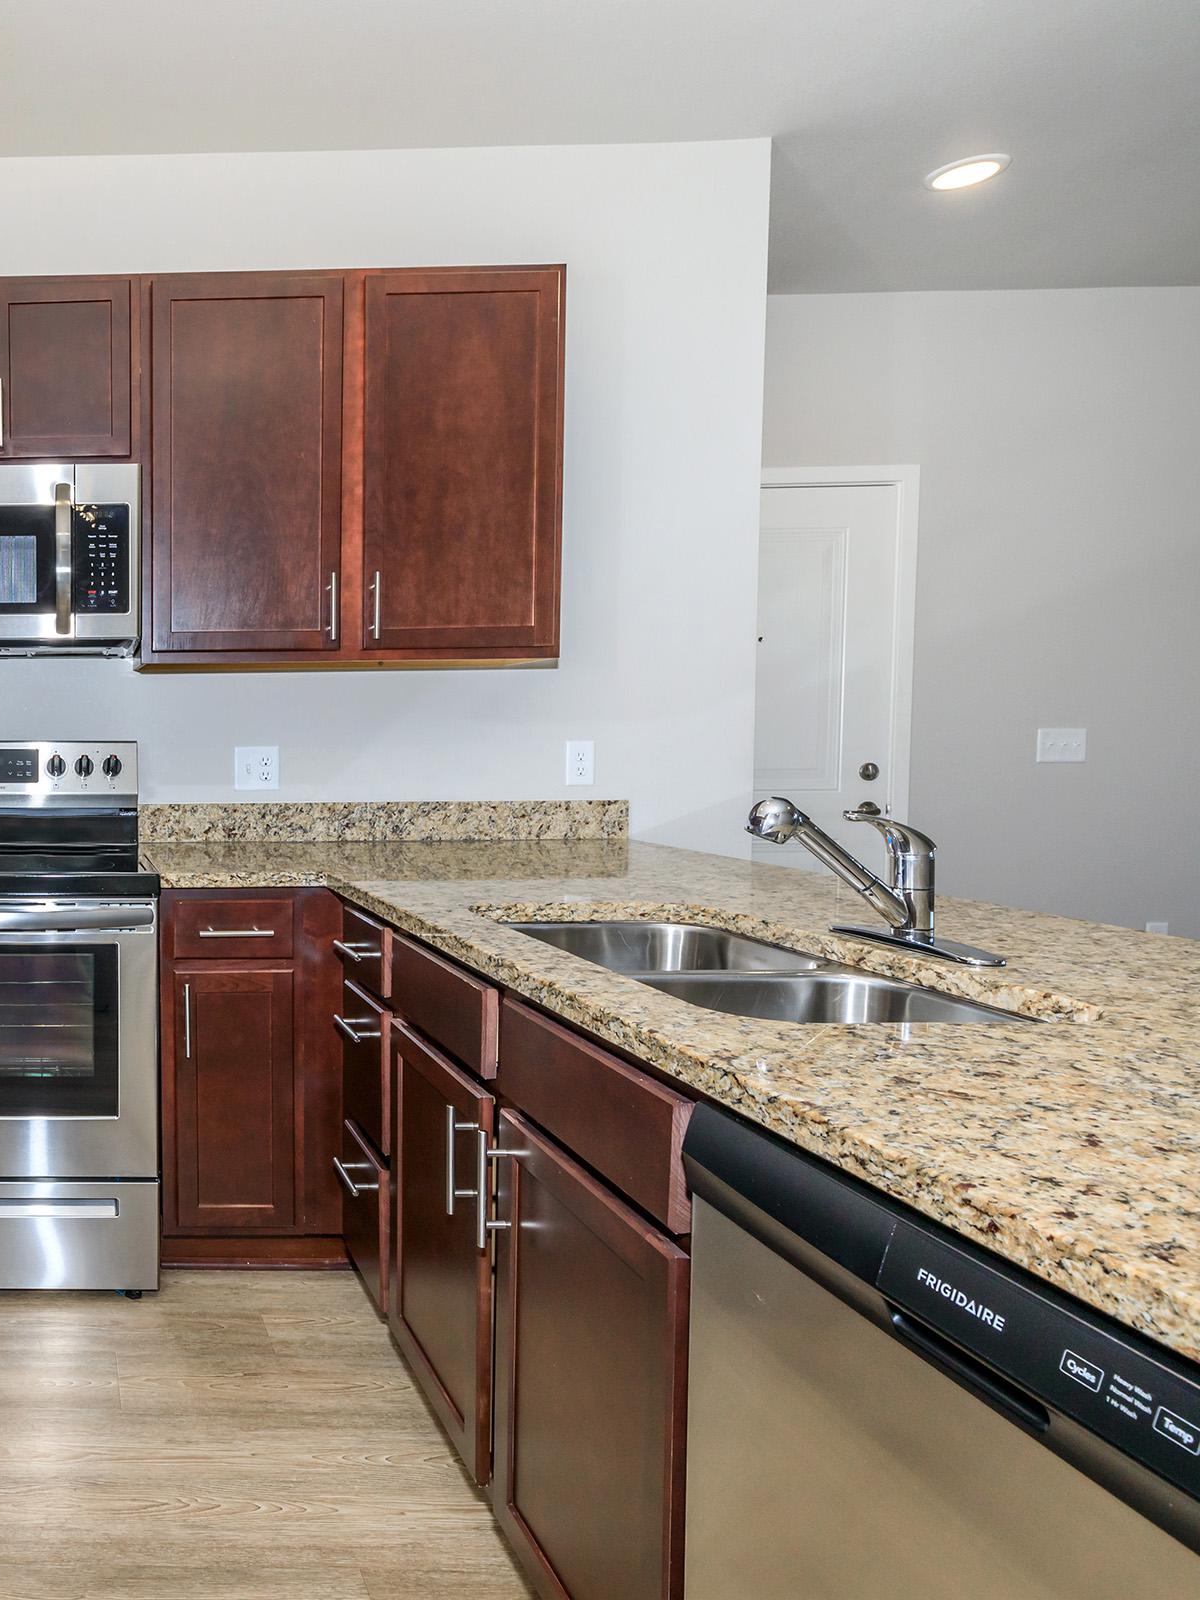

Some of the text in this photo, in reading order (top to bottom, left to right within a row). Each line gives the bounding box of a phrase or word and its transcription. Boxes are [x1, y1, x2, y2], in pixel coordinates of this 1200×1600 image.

[916, 1267, 1006, 1332] FRIGIDAIRE
[1066, 1359, 1097, 1384] Cycles
[1163, 1416, 1194, 1445] Temp
